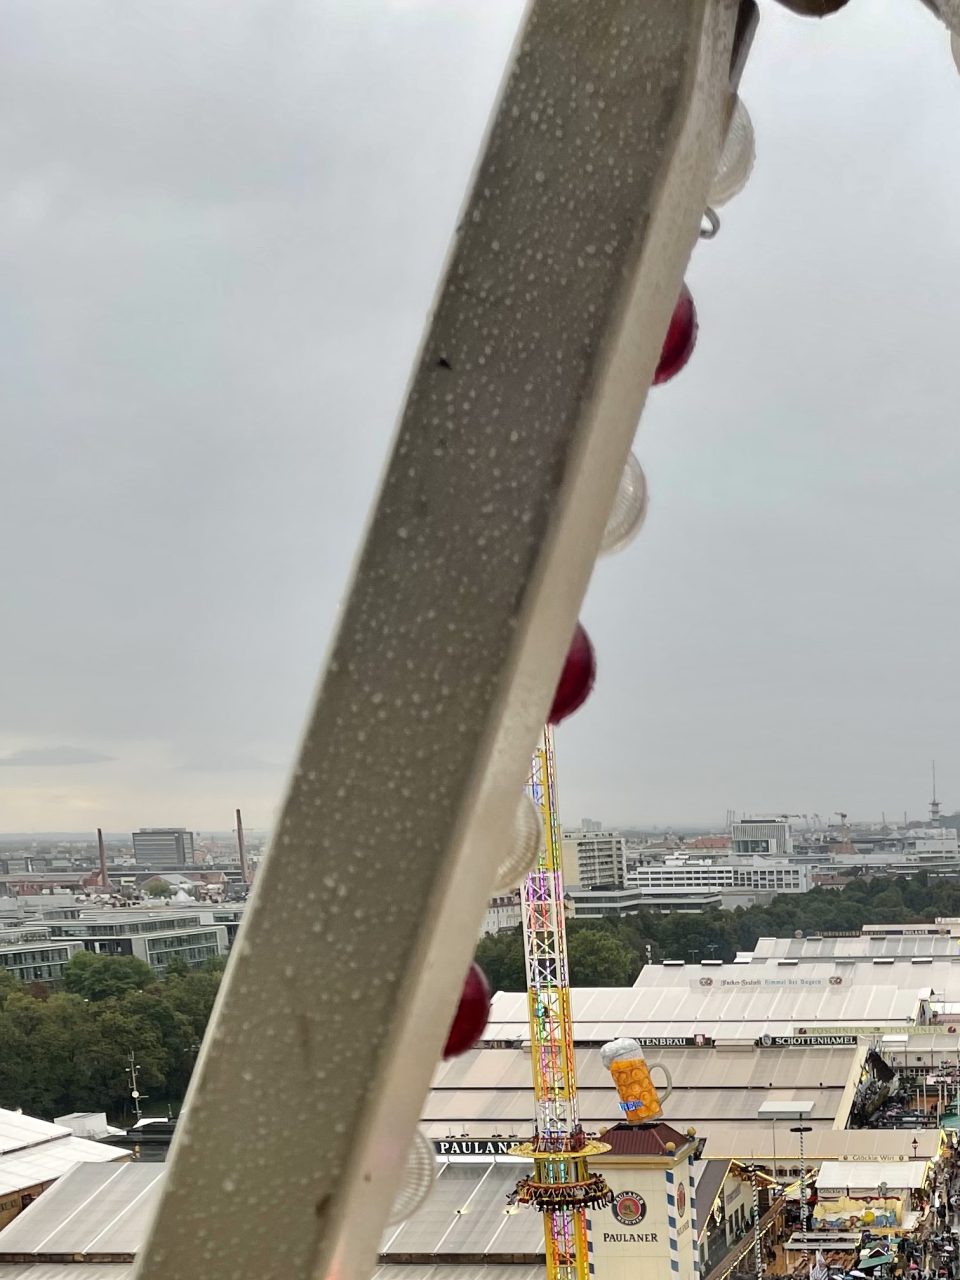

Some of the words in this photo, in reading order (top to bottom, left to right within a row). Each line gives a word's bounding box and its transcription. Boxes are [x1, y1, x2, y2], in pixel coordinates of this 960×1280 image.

[775, 1035, 856, 1045] SCHOTTENHAMEL
[613, 1191, 645, 1205] PAULANER
[603, 1232, 659, 1243] PAULANER
